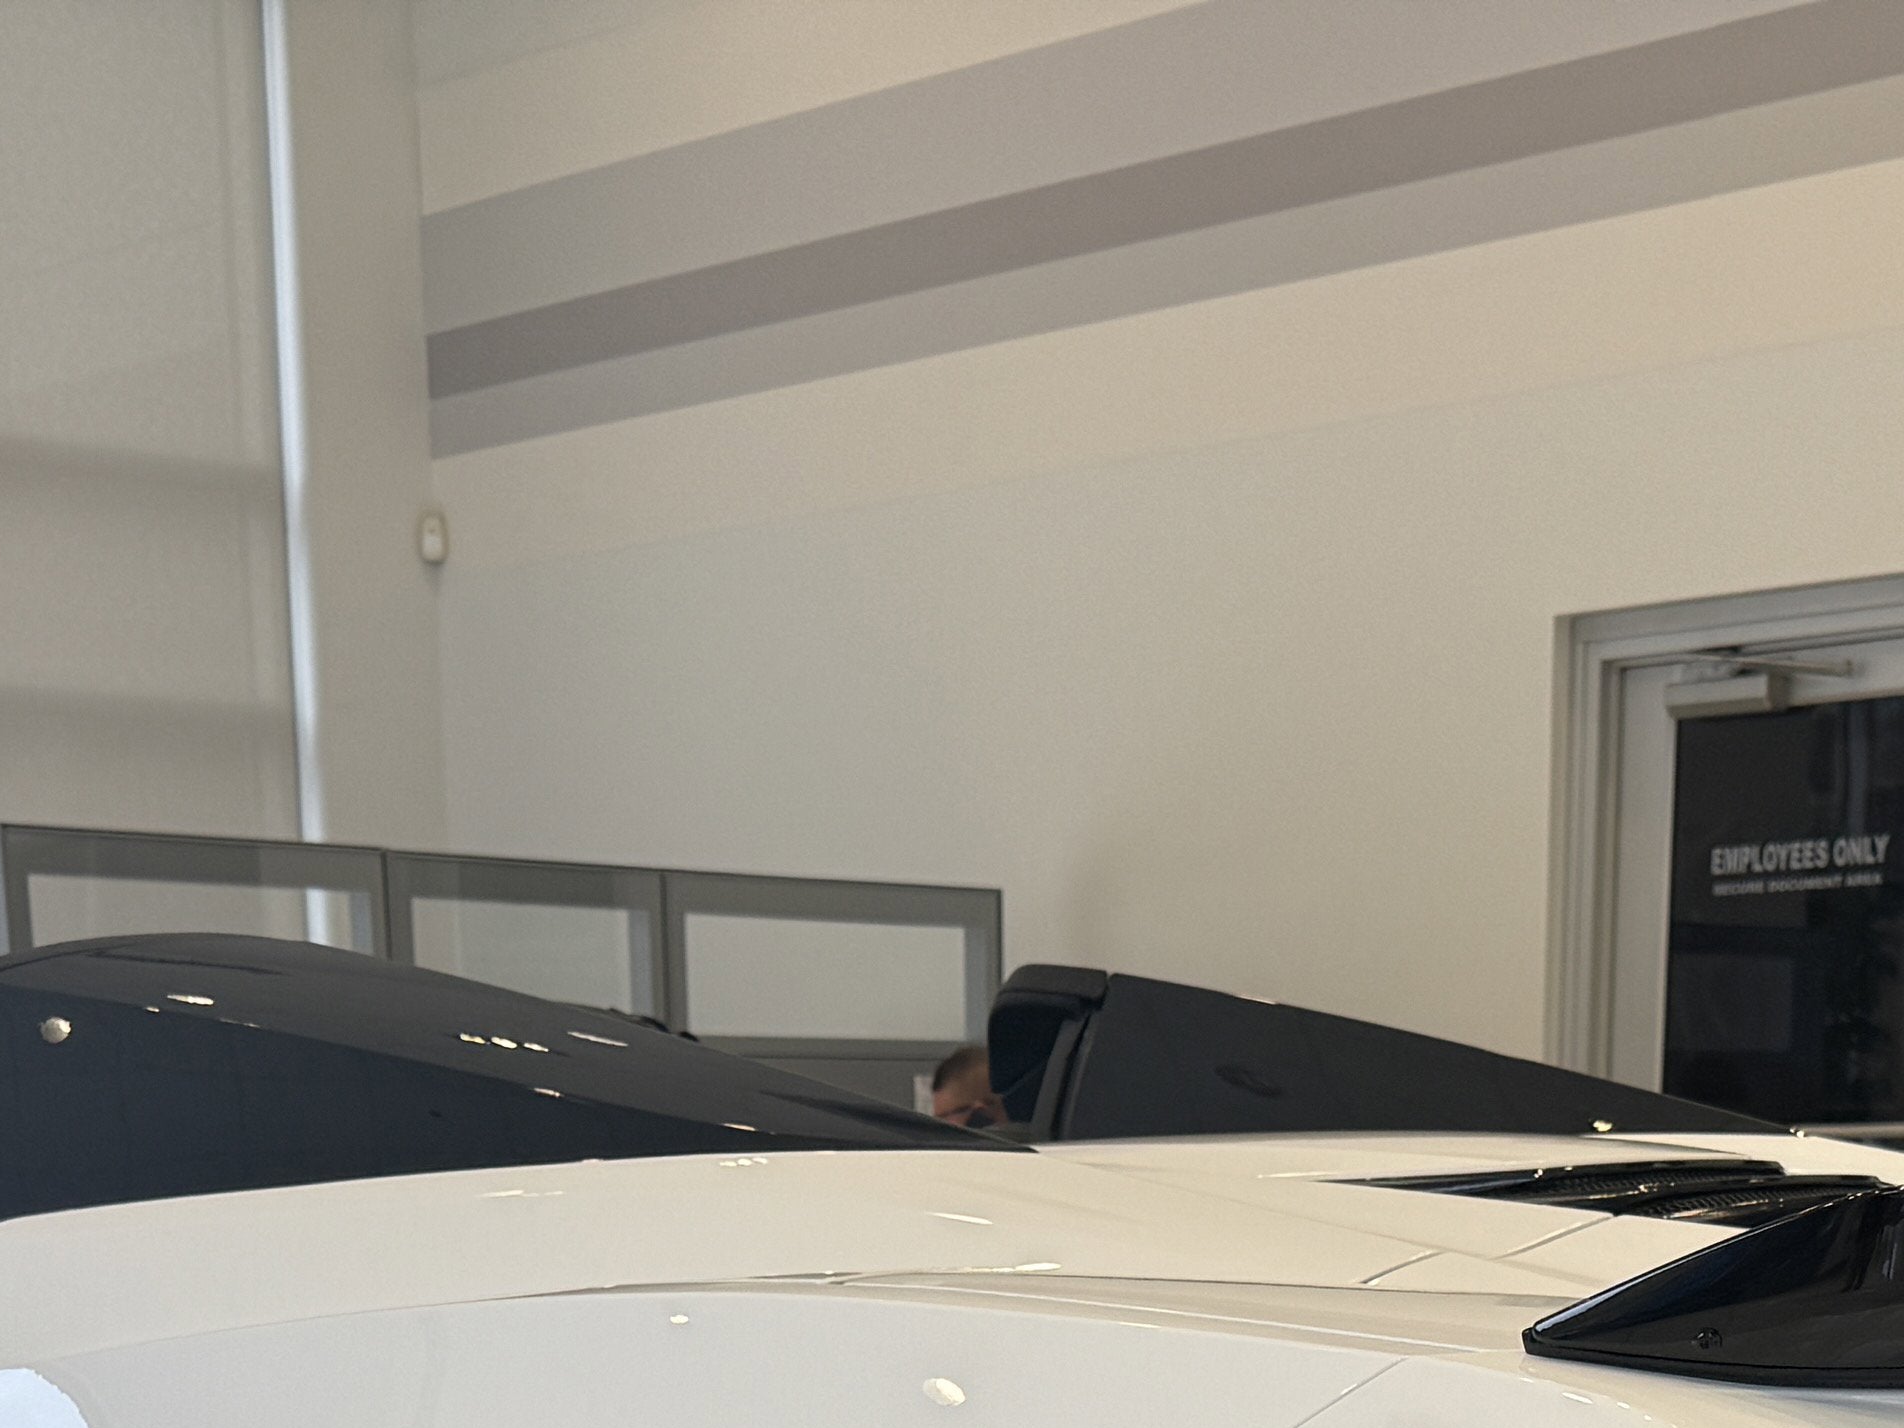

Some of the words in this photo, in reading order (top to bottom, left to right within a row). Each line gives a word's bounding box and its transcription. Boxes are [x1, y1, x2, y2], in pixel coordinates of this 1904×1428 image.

[1710, 839, 1830, 876] EMPLOYEES
[1832, 833, 1891, 868] ONLY
[1767, 874, 1844, 893] DOCUMENT
